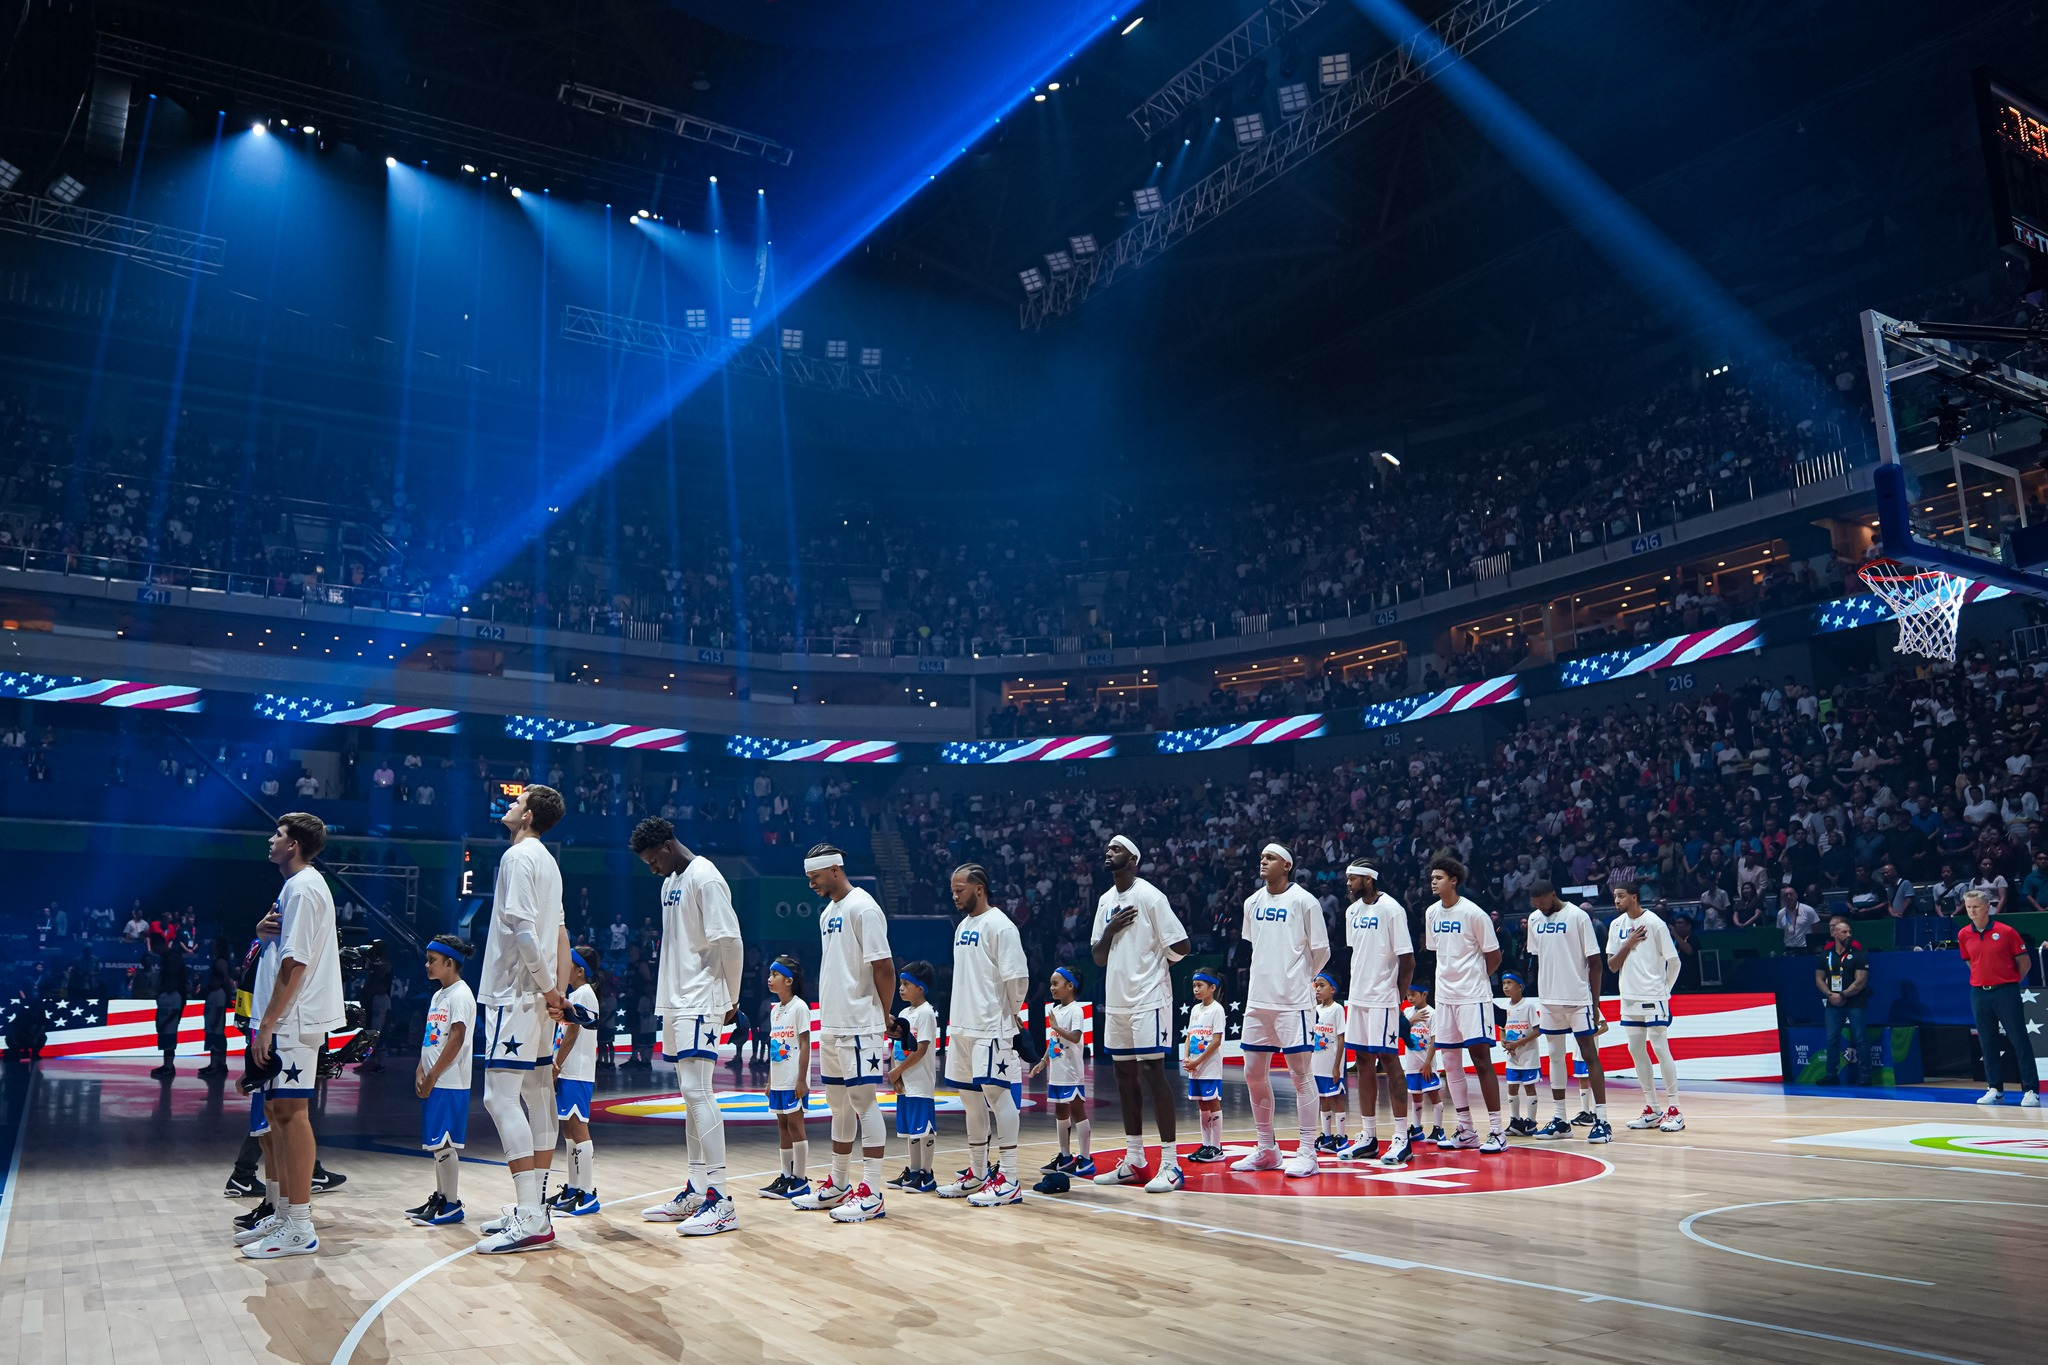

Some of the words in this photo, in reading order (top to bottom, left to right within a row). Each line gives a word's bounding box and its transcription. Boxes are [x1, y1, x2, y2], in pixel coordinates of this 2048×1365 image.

[1635, 534, 1659, 552] 416
[143, 590, 166, 603] 411
[1377, 610, 1395, 625] 415
[479, 625, 502, 639] 412
[701, 649, 721, 662] 413
[919, 661, 944, 672] 414A
[1668, 673, 1693, 692] 216
[1384, 732, 1401, 747] 215
[1065, 765, 1087, 777] 214
[500, 783, 523, 797] 7:30
[1255, 907, 1288, 922] USA
[1353, 916, 1379, 930] USA
[1433, 920, 1462, 934] USA
[1536, 922, 1567, 934] USA
